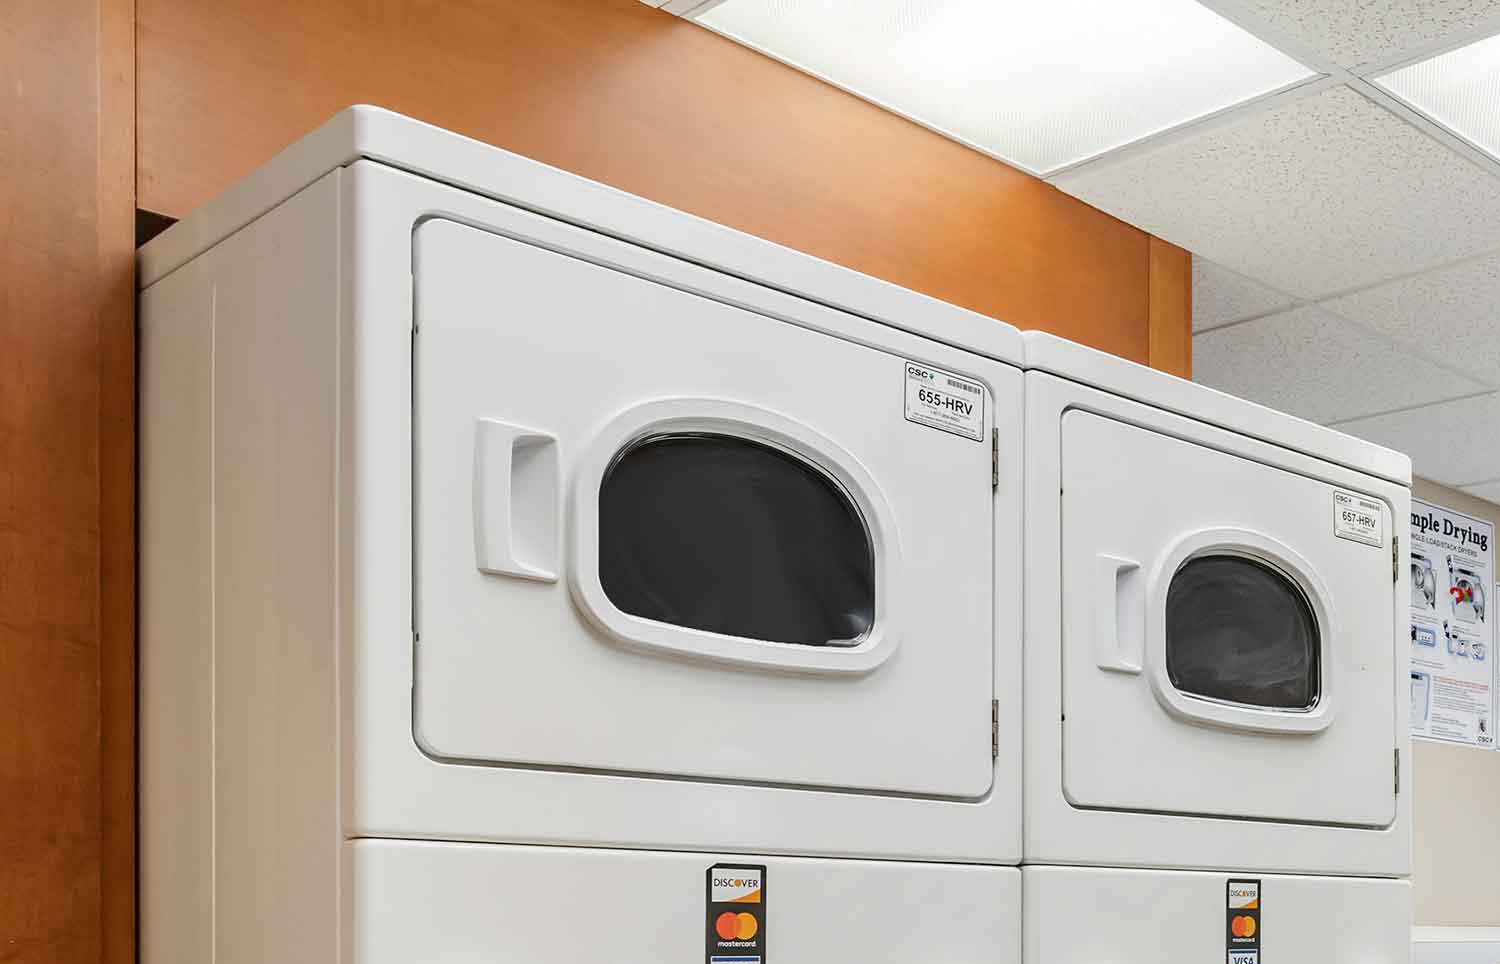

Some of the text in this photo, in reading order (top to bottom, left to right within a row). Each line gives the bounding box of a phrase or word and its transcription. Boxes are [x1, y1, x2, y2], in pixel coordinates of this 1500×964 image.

[908, 367, 928, 378] CSC
[919, 389, 973, 415] 655-HRV
[1343, 511, 1376, 528] 657-HRV
[1443, 518, 1488, 551] Drying
[713, 878, 758, 888] DISCOVER
